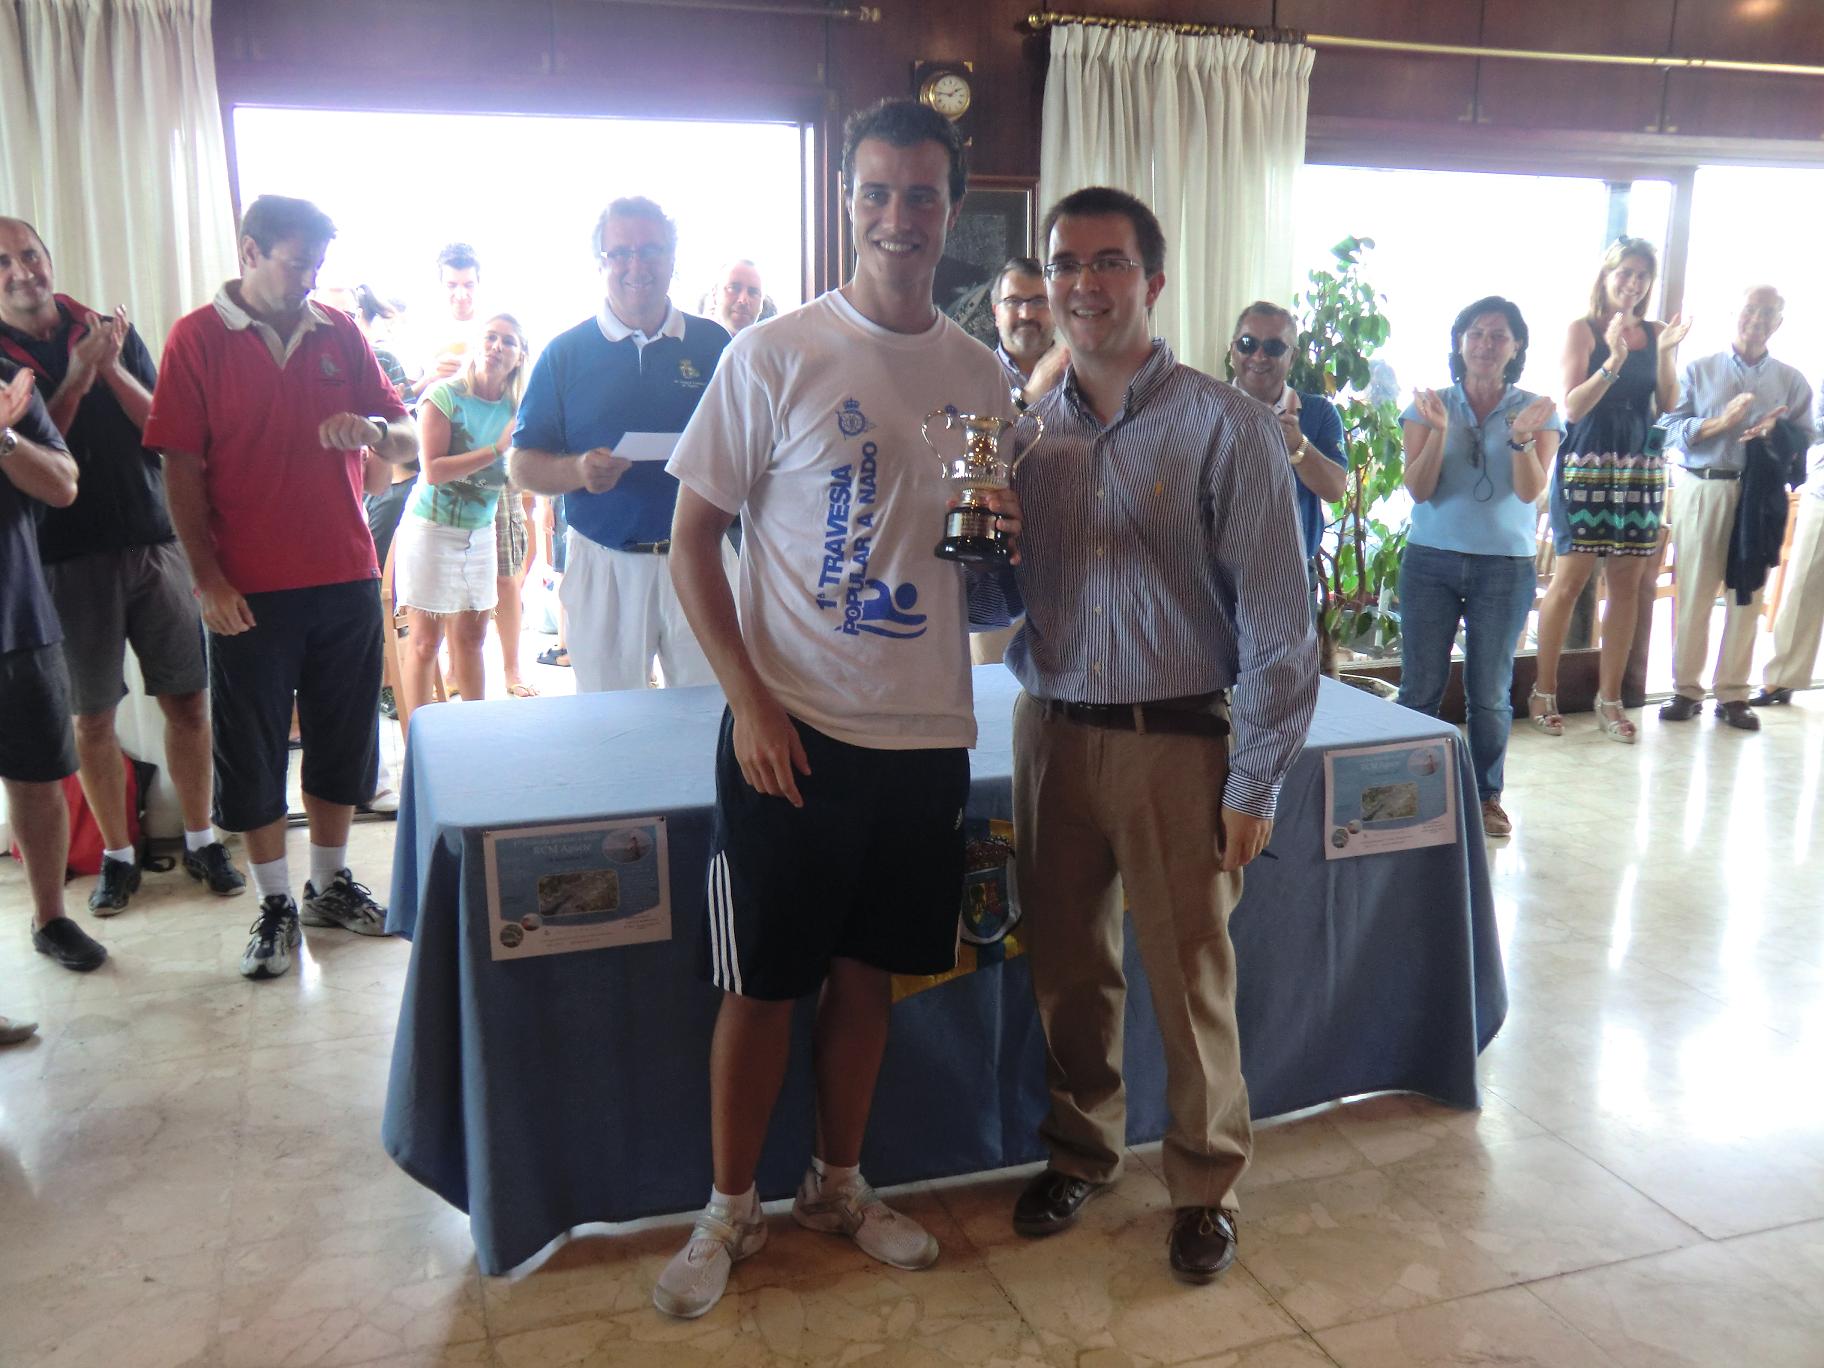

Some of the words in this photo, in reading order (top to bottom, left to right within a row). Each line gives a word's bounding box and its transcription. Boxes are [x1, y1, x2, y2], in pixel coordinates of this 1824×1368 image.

[859, 441, 877, 503] NADO
[818, 464, 852, 588] TRAVESIA
[857, 512, 873, 527] A
[843, 536, 871, 635] POPULAR
